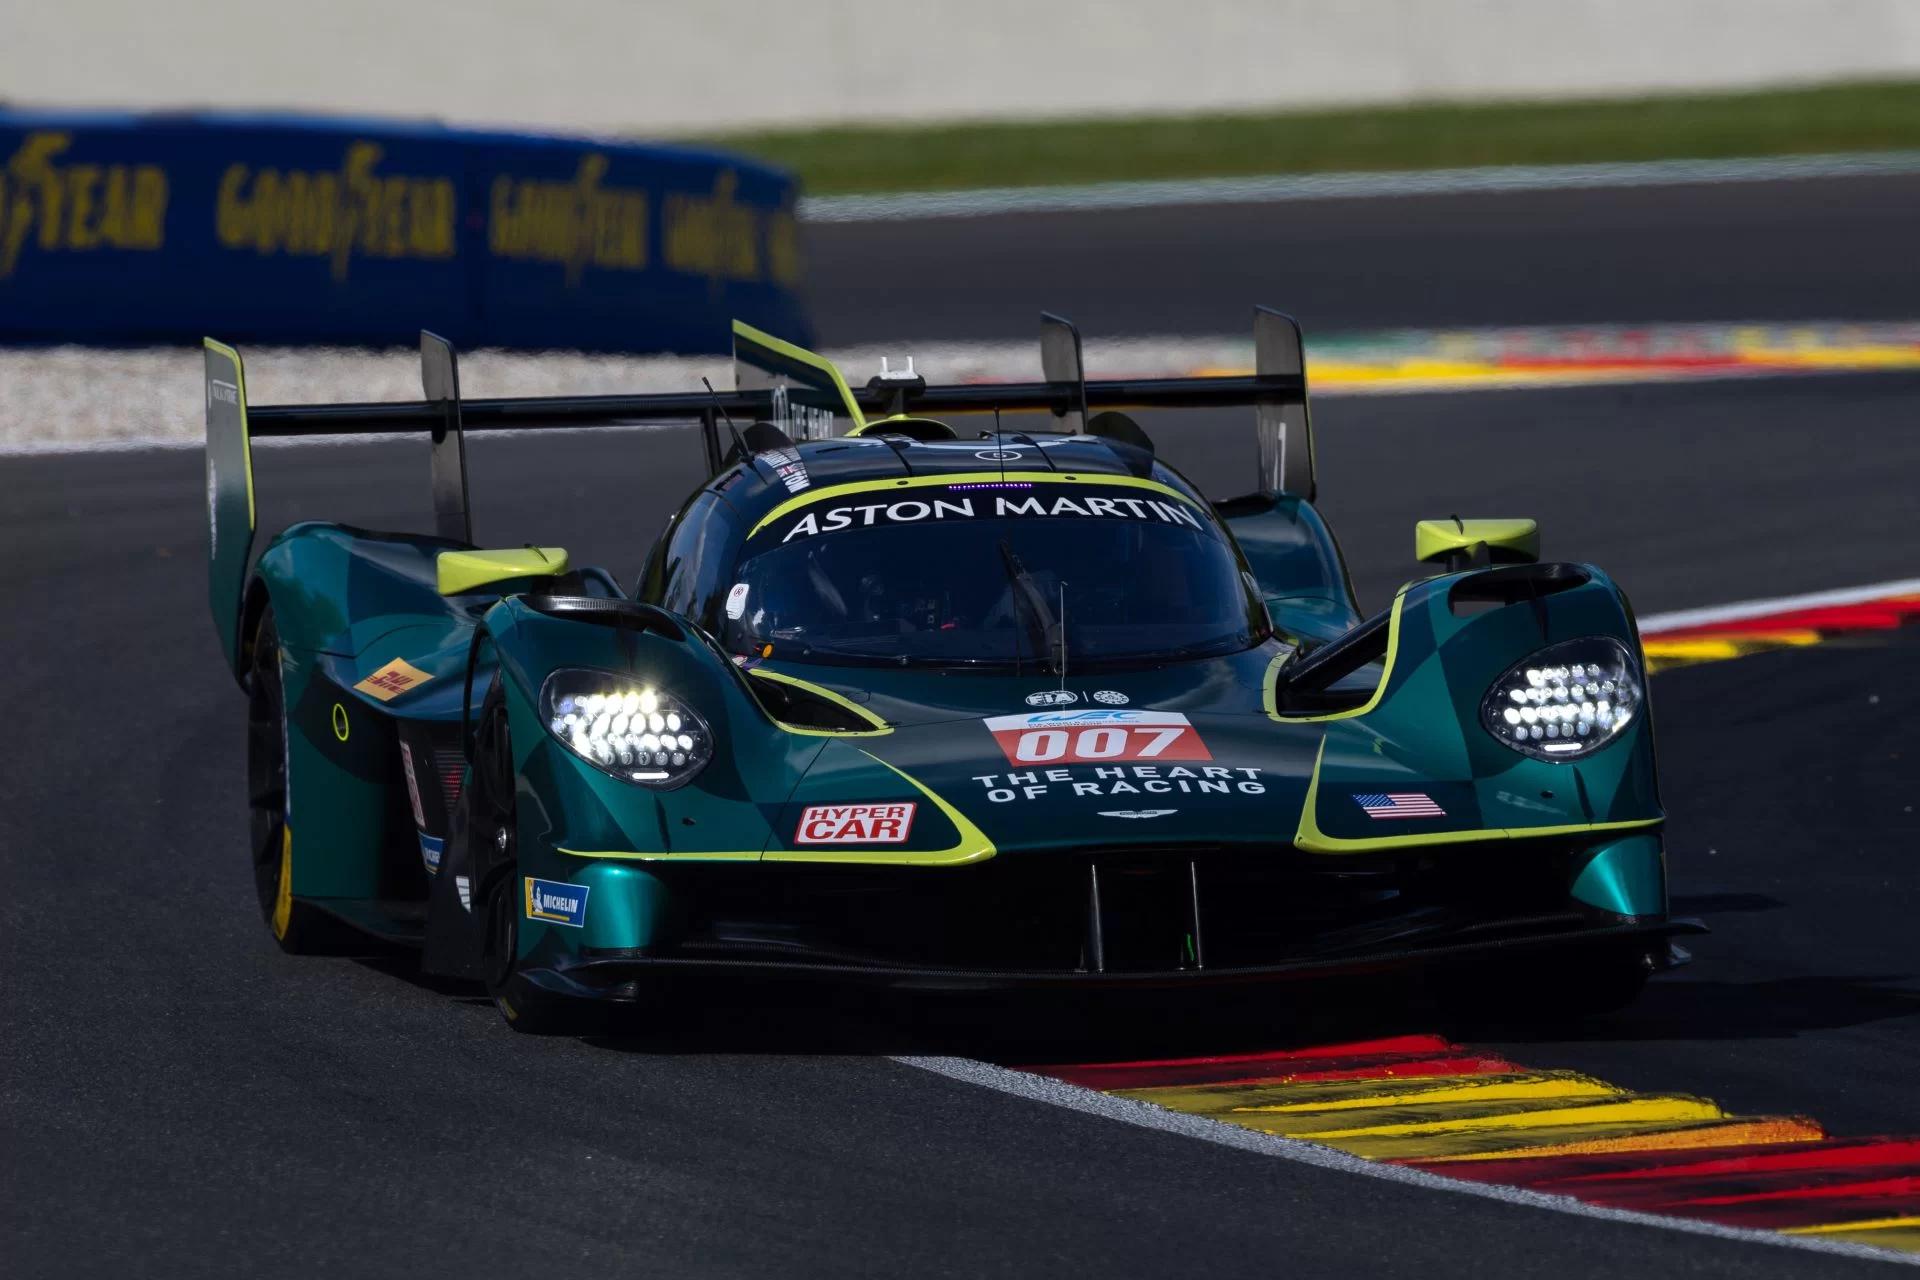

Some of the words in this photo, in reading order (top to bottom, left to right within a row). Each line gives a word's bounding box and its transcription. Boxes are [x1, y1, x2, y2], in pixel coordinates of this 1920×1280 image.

[782, 497, 975, 543] ASTON
[996, 496, 1203, 532] MARTIN
[1027, 691, 1074, 706] FIA
[1015, 727, 1185, 762] 007
[972, 769, 1074, 788] THE
[1095, 766, 1262, 780] HEART
[987, 785, 1048, 802] OF
[1076, 780, 1266, 796] RACING
[809, 806, 906, 820] HYPER
[805, 819, 901, 839] CAR
[543, 893, 579, 914] MICHELIN
